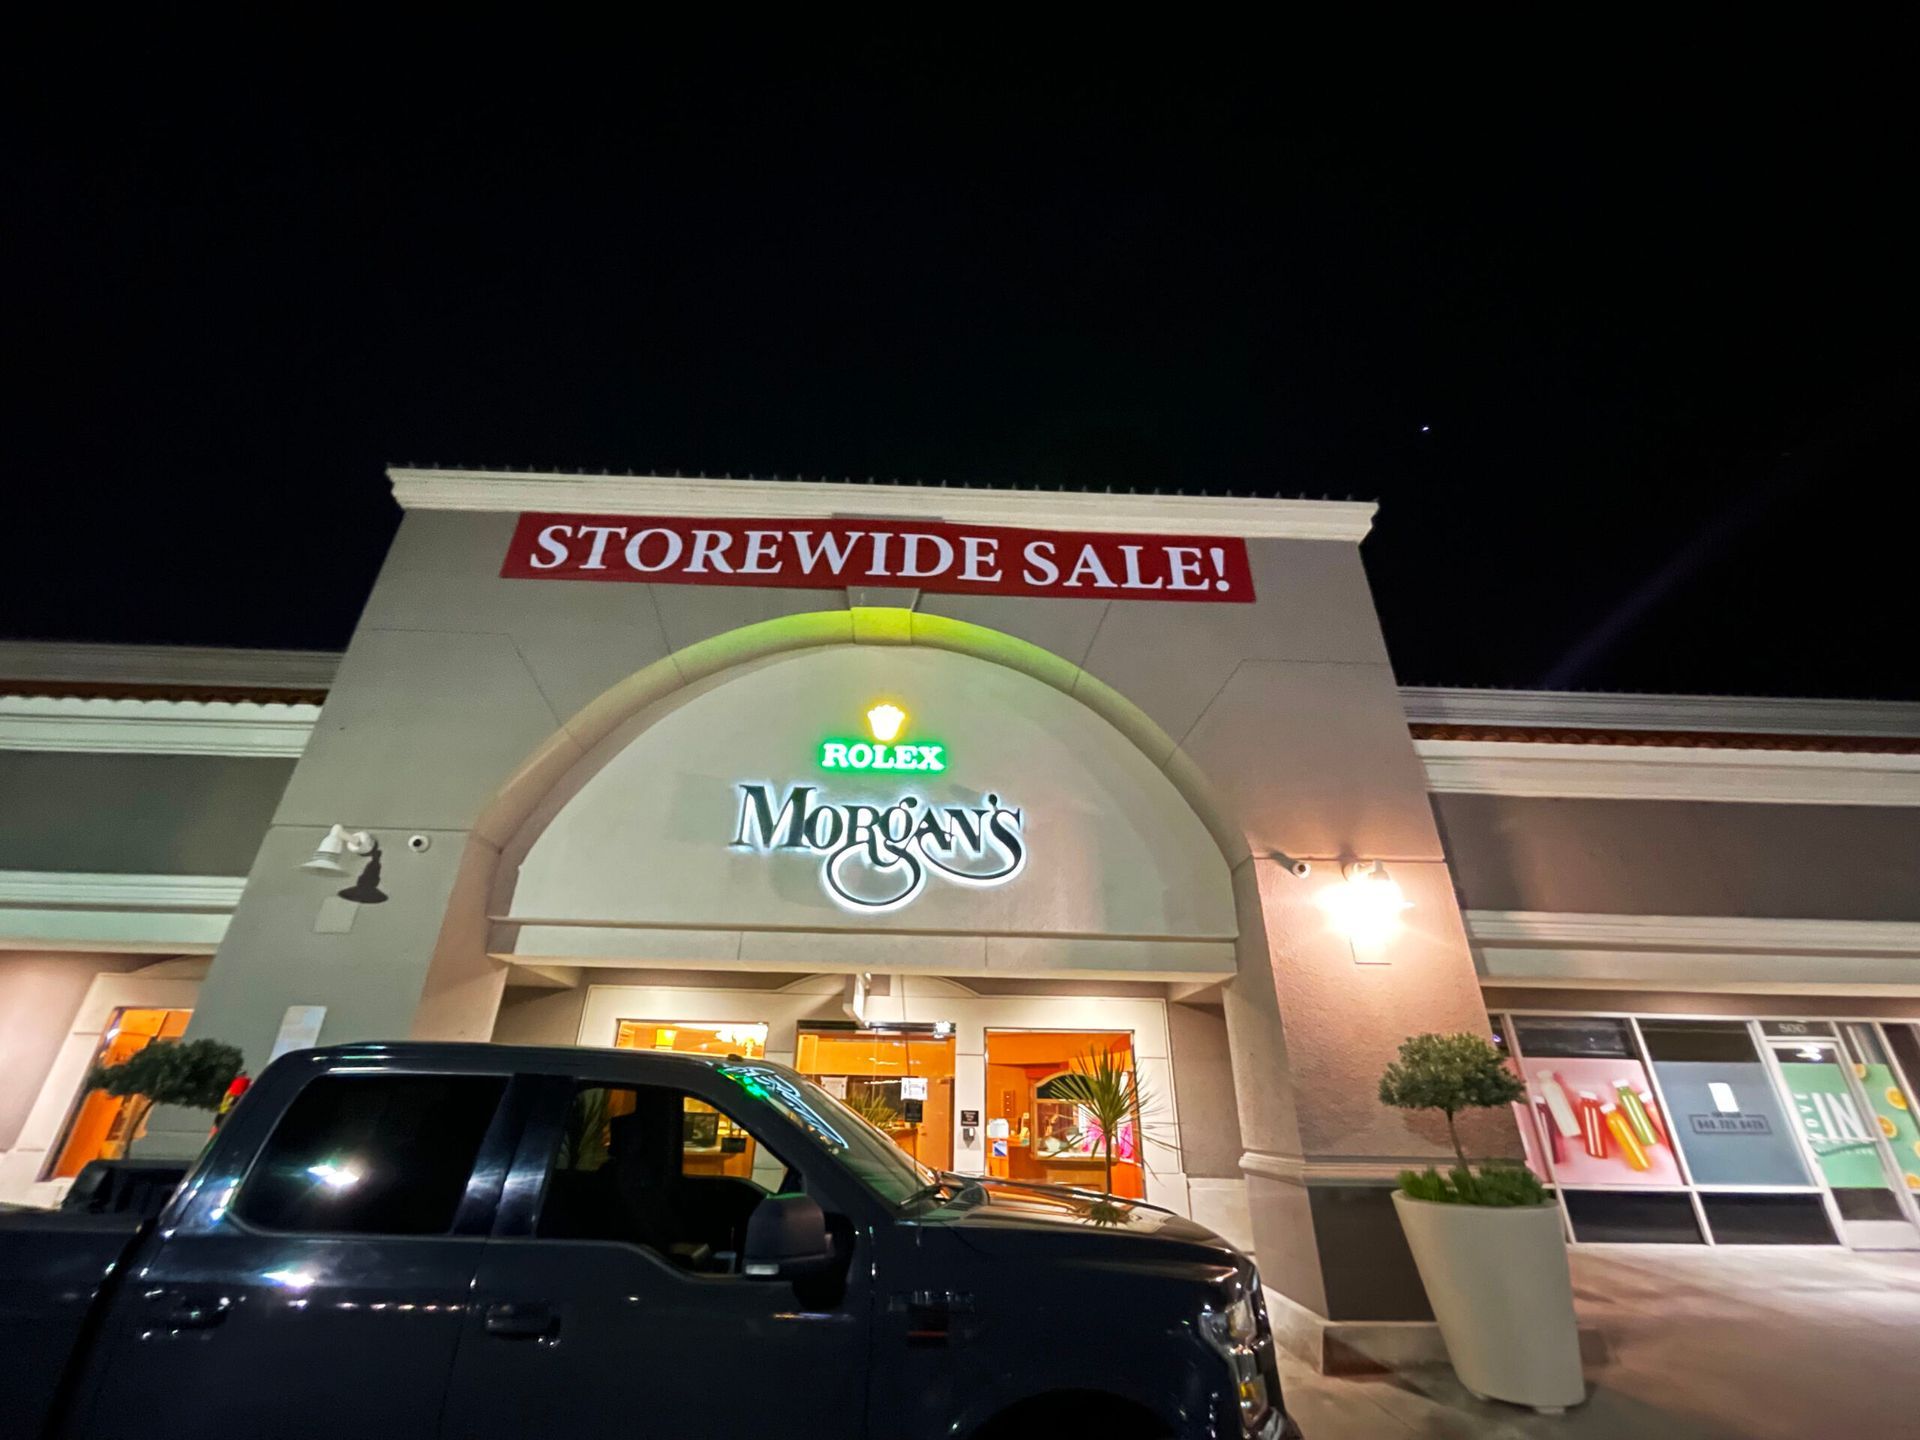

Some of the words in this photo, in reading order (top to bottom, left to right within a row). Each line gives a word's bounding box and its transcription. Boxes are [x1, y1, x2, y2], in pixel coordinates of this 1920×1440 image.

[529, 524, 1003, 583] STOREWIDE
[1022, 540, 1230, 592] SALE!
[821, 743, 944, 771] ROLEX
[1811, 1093, 1870, 1143] IN
